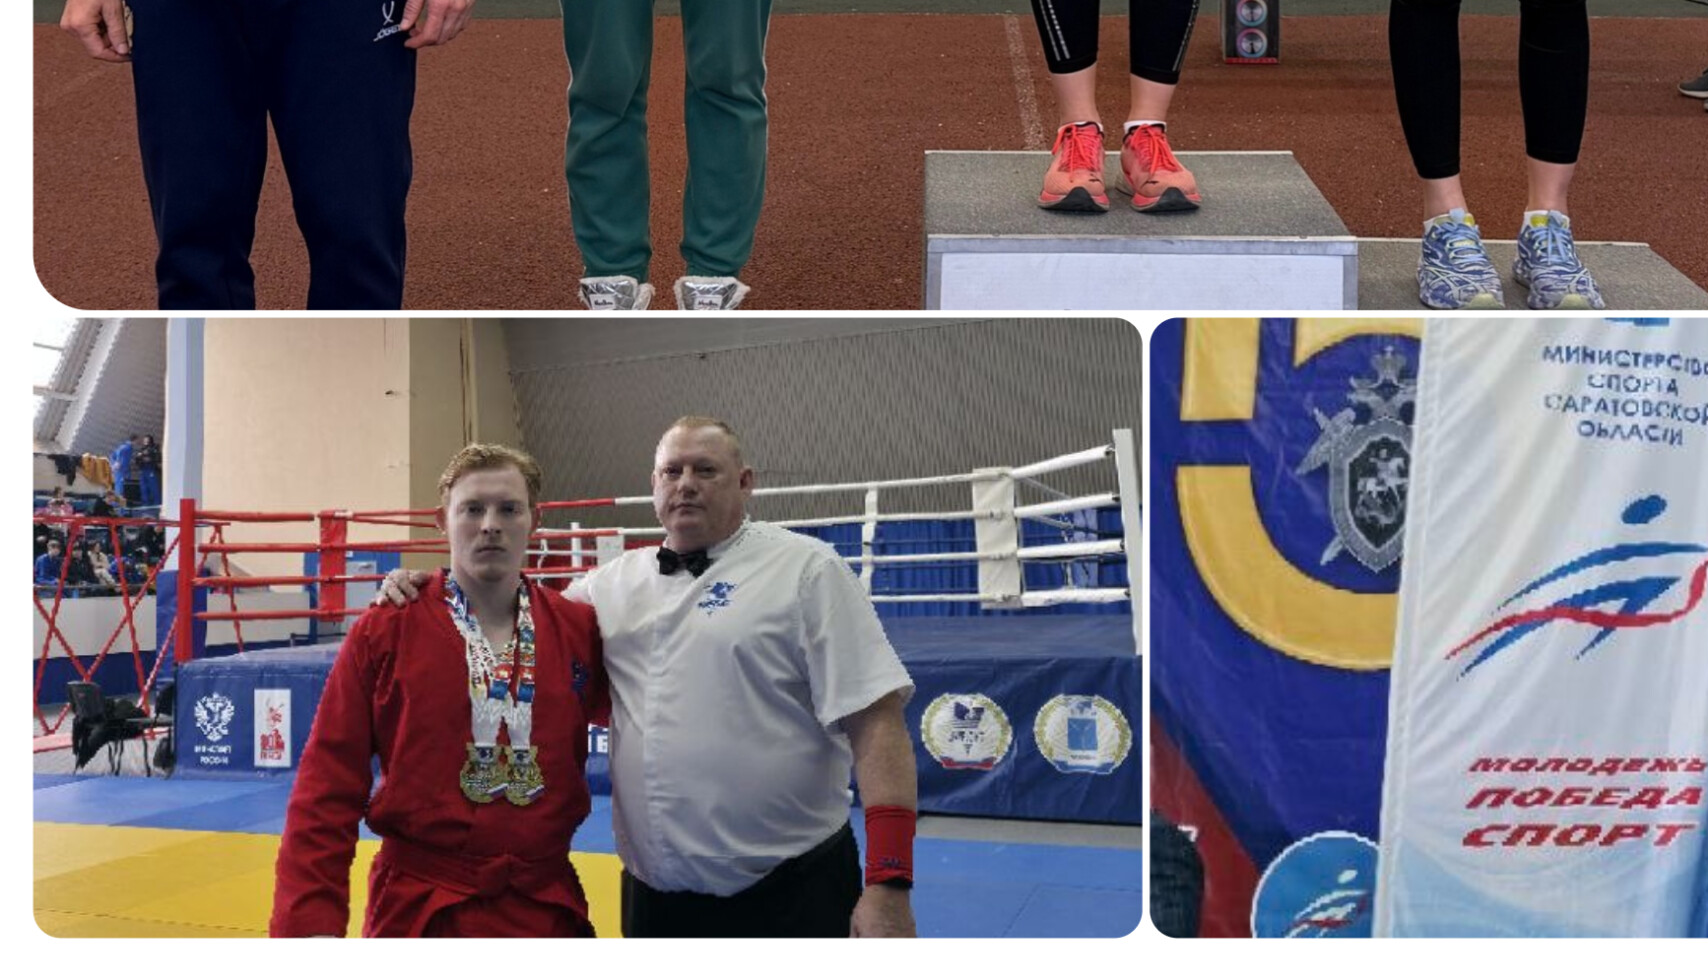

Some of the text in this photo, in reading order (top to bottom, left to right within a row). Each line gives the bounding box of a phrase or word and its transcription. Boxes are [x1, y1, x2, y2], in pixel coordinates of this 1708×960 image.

[1588, 374, 1679, 396] СПОРТА
[1577, 420, 1683, 445] ОБЛАСТИ
[1469, 757, 1708, 775] МОЛОДЕЖЬ
[1465, 787, 1703, 809] ПОБЕДА
[1462, 824, 1696, 847] СПОРТ
